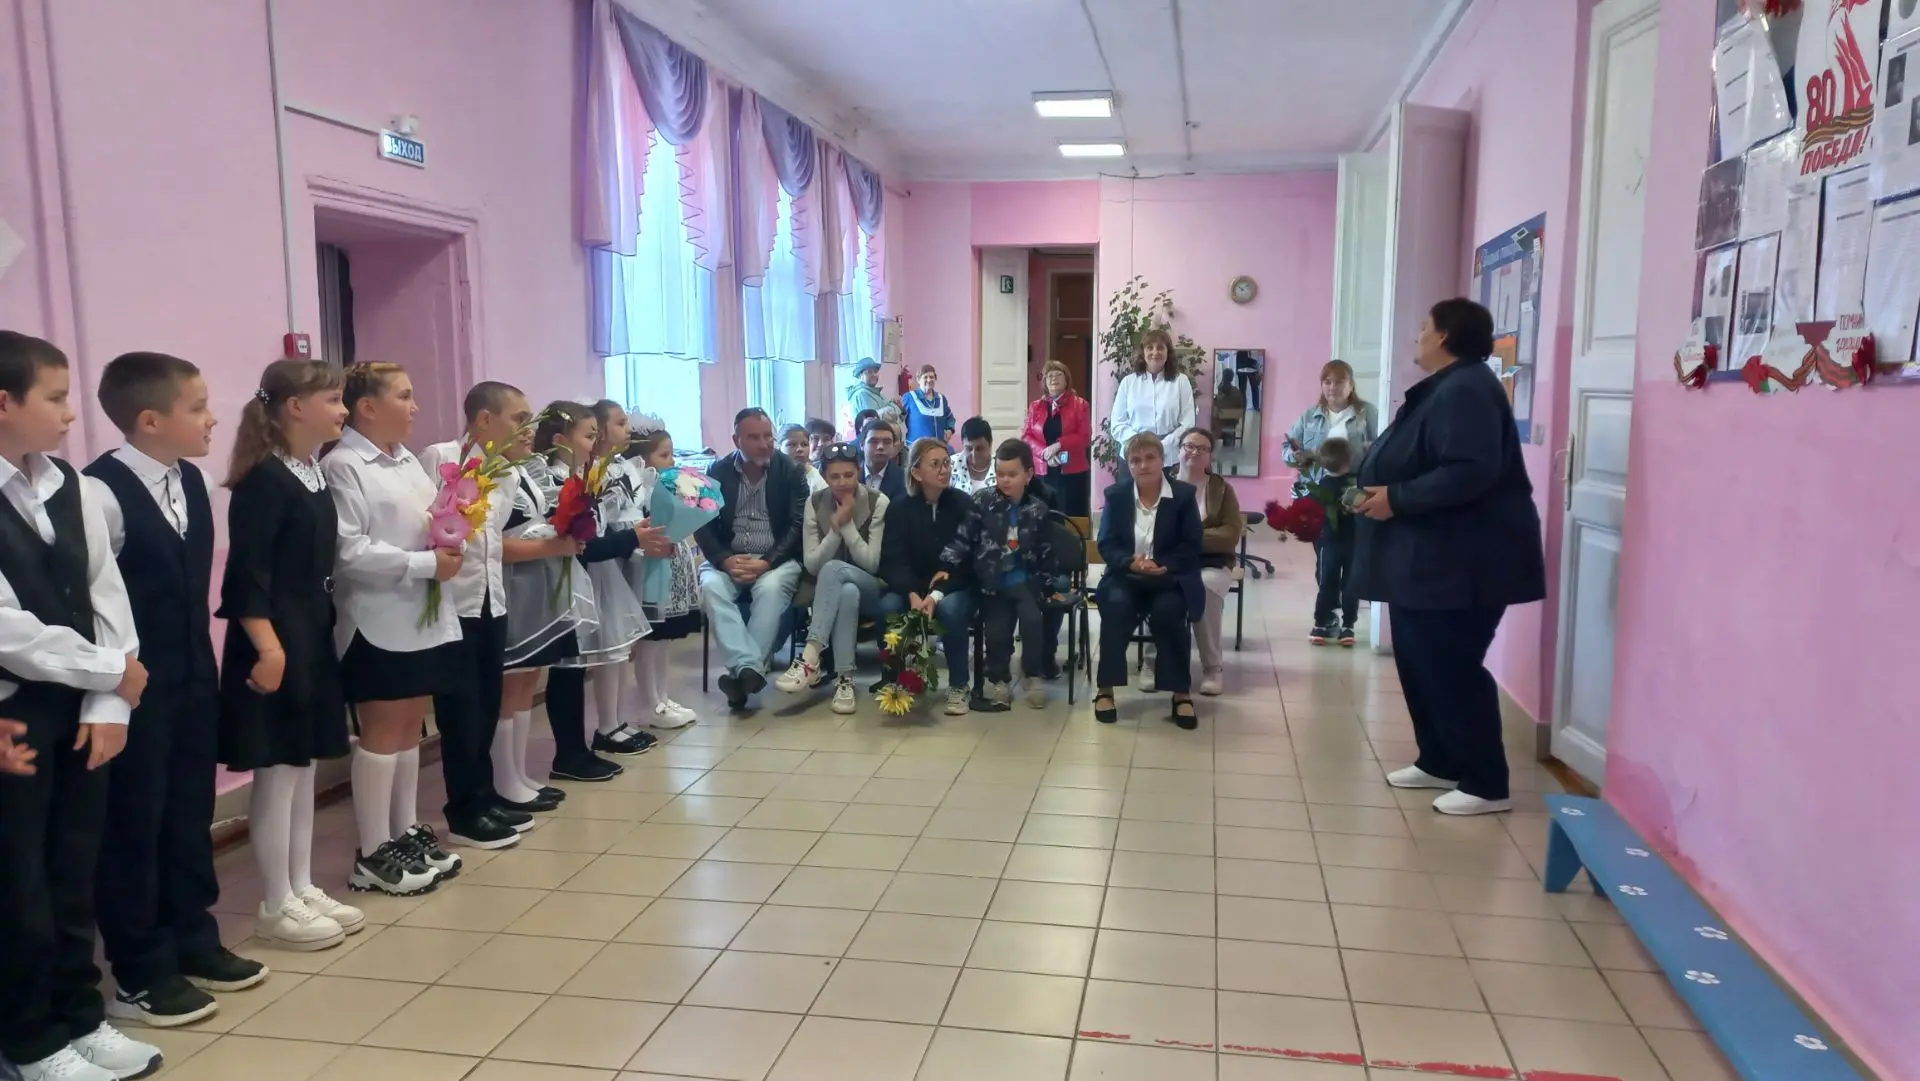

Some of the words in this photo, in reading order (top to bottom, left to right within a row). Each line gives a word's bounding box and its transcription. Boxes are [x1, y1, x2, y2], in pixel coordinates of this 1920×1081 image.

[1806, 69, 1836, 133] 80
[384, 135, 422, 161] ВЫХОД
[1800, 125, 1871, 176] ПОБЕДА!
